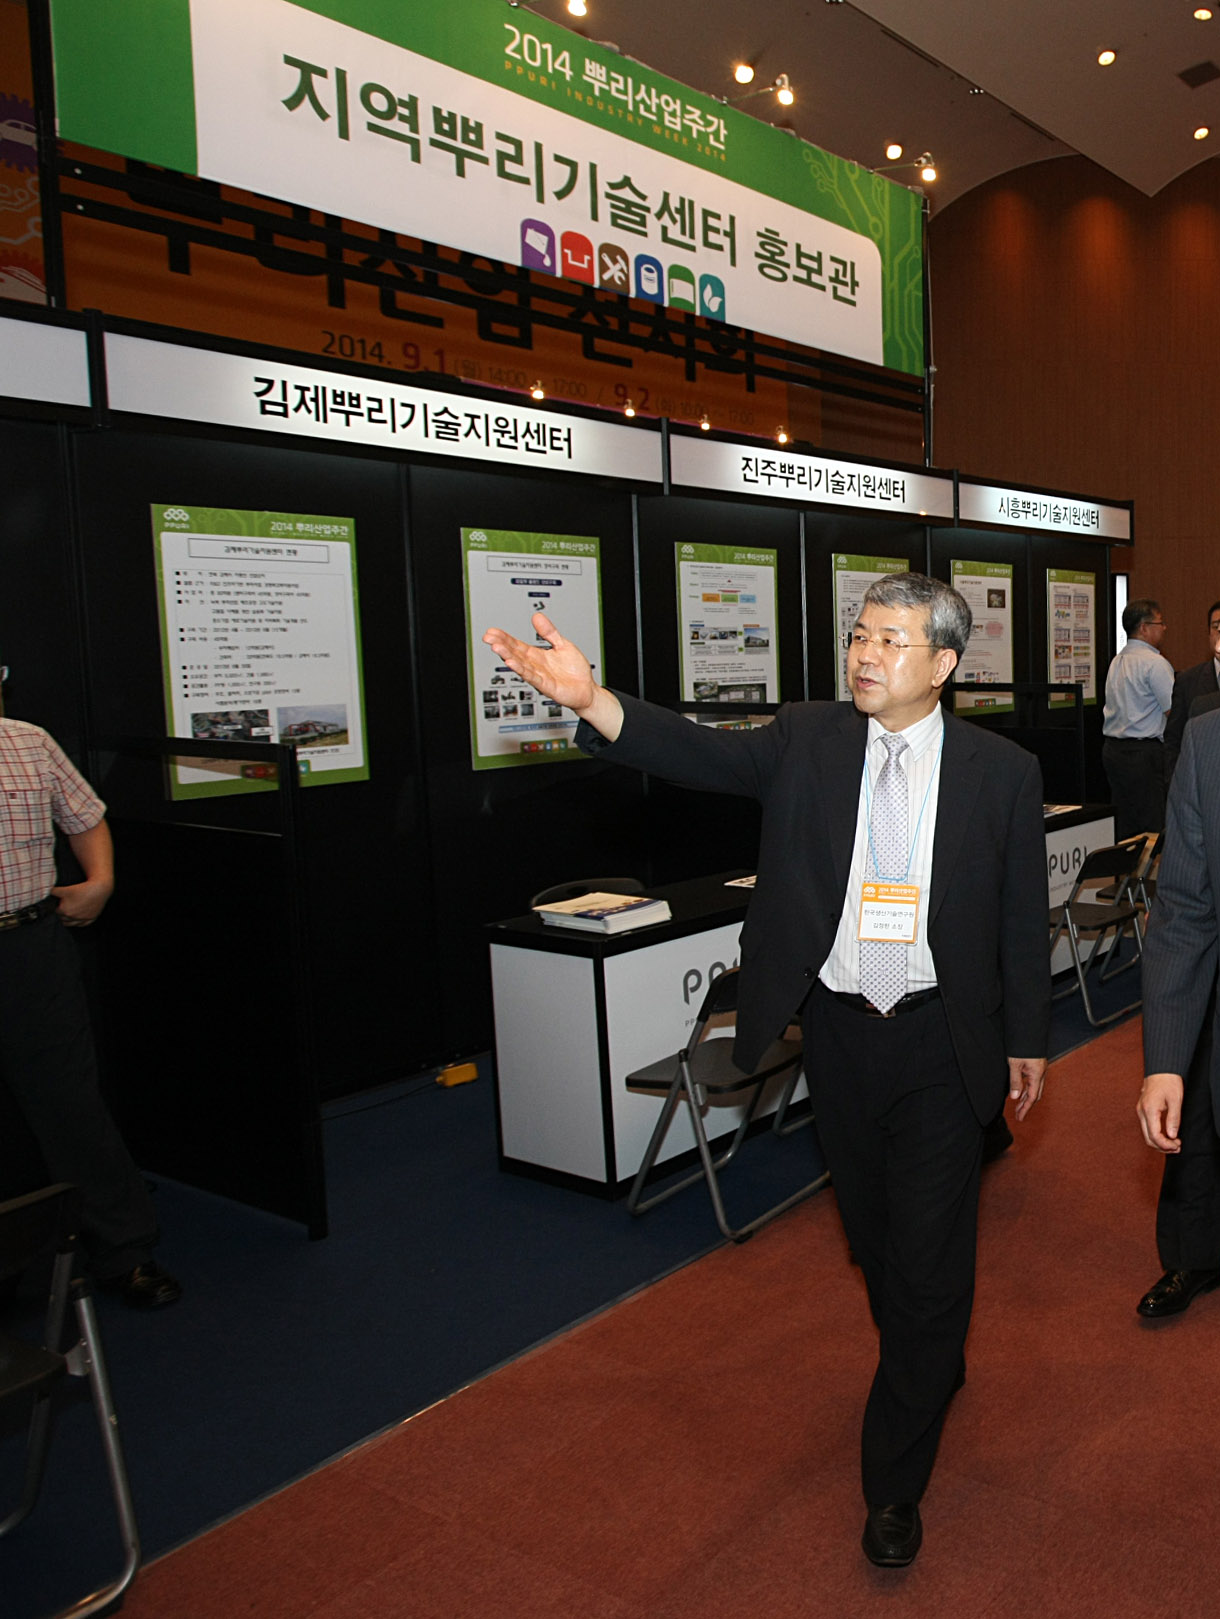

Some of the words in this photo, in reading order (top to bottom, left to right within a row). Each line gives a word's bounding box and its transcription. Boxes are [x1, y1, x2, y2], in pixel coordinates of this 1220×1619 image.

[504, 23, 573, 81] 2014
[583, 58, 728, 150] 뿌리산업주간
[505, 61, 556, 91] PPURI
[567, 87, 644, 127] INDUSTRY
[652, 124, 689, 146] WEEK
[697, 143, 727, 162] 2014
[281, 53, 738, 267] 지역뿌리기술센터
[754, 227, 859, 308] 홍보관
[253, 376, 573, 459] 김제뿌리기술지원센터
[741, 456, 905, 504] 진주뿌리기술지원센터
[998, 496, 1099, 530] 시흥뿌리기술지원센터
[270, 521, 293, 532] 2014
